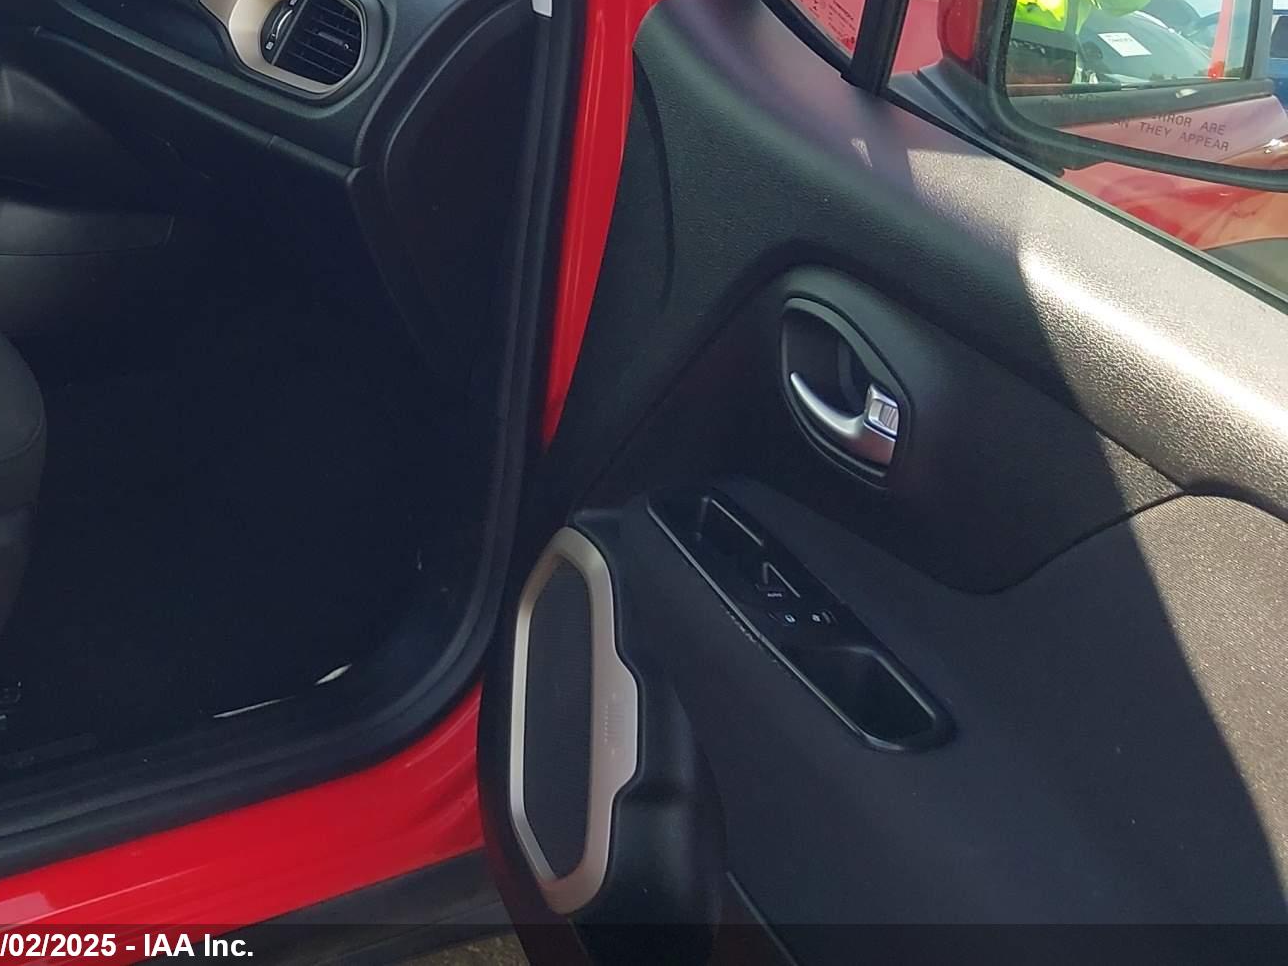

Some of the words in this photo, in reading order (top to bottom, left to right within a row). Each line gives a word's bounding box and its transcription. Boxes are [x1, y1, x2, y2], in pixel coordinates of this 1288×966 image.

[1139, 121, 1172, 139] THEY
[1177, 131, 1229, 152] APPEAR
[1200, 121, 1227, 135] ARE
